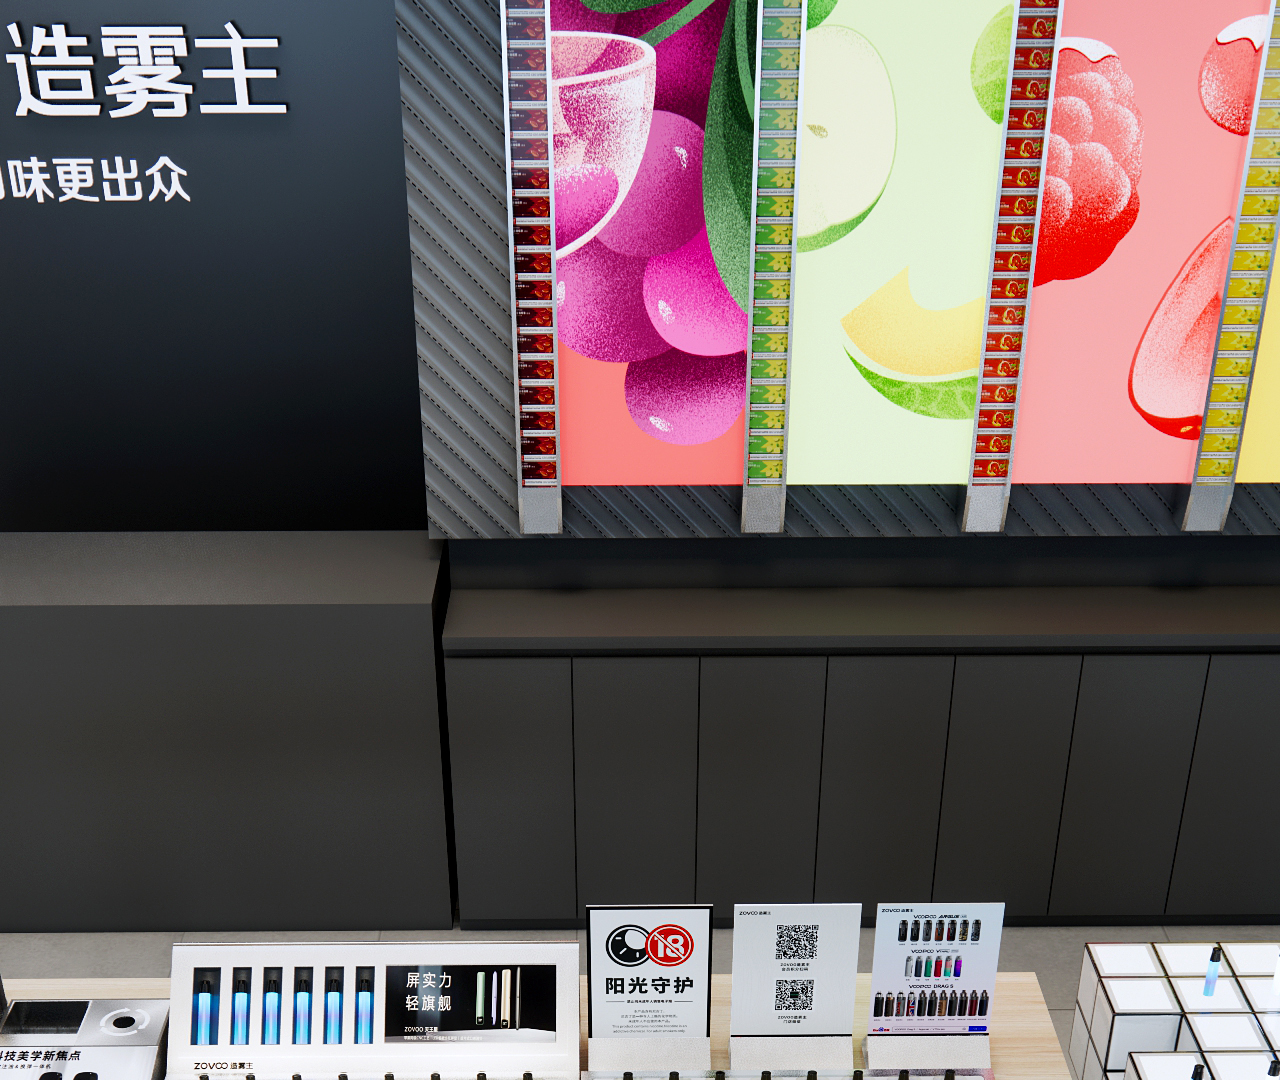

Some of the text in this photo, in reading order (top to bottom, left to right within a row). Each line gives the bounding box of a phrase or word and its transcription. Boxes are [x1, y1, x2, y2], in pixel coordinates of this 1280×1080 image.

[5, 22, 288, 119] 造雾主
[654, 934, 685, 958] 18
[405, 972, 453, 989] 屏实力
[605, 976, 694, 995] 阳光守护
[405, 994, 452, 1012] 轻旗舰
[194, 1062, 228, 1070] ZOVOO
